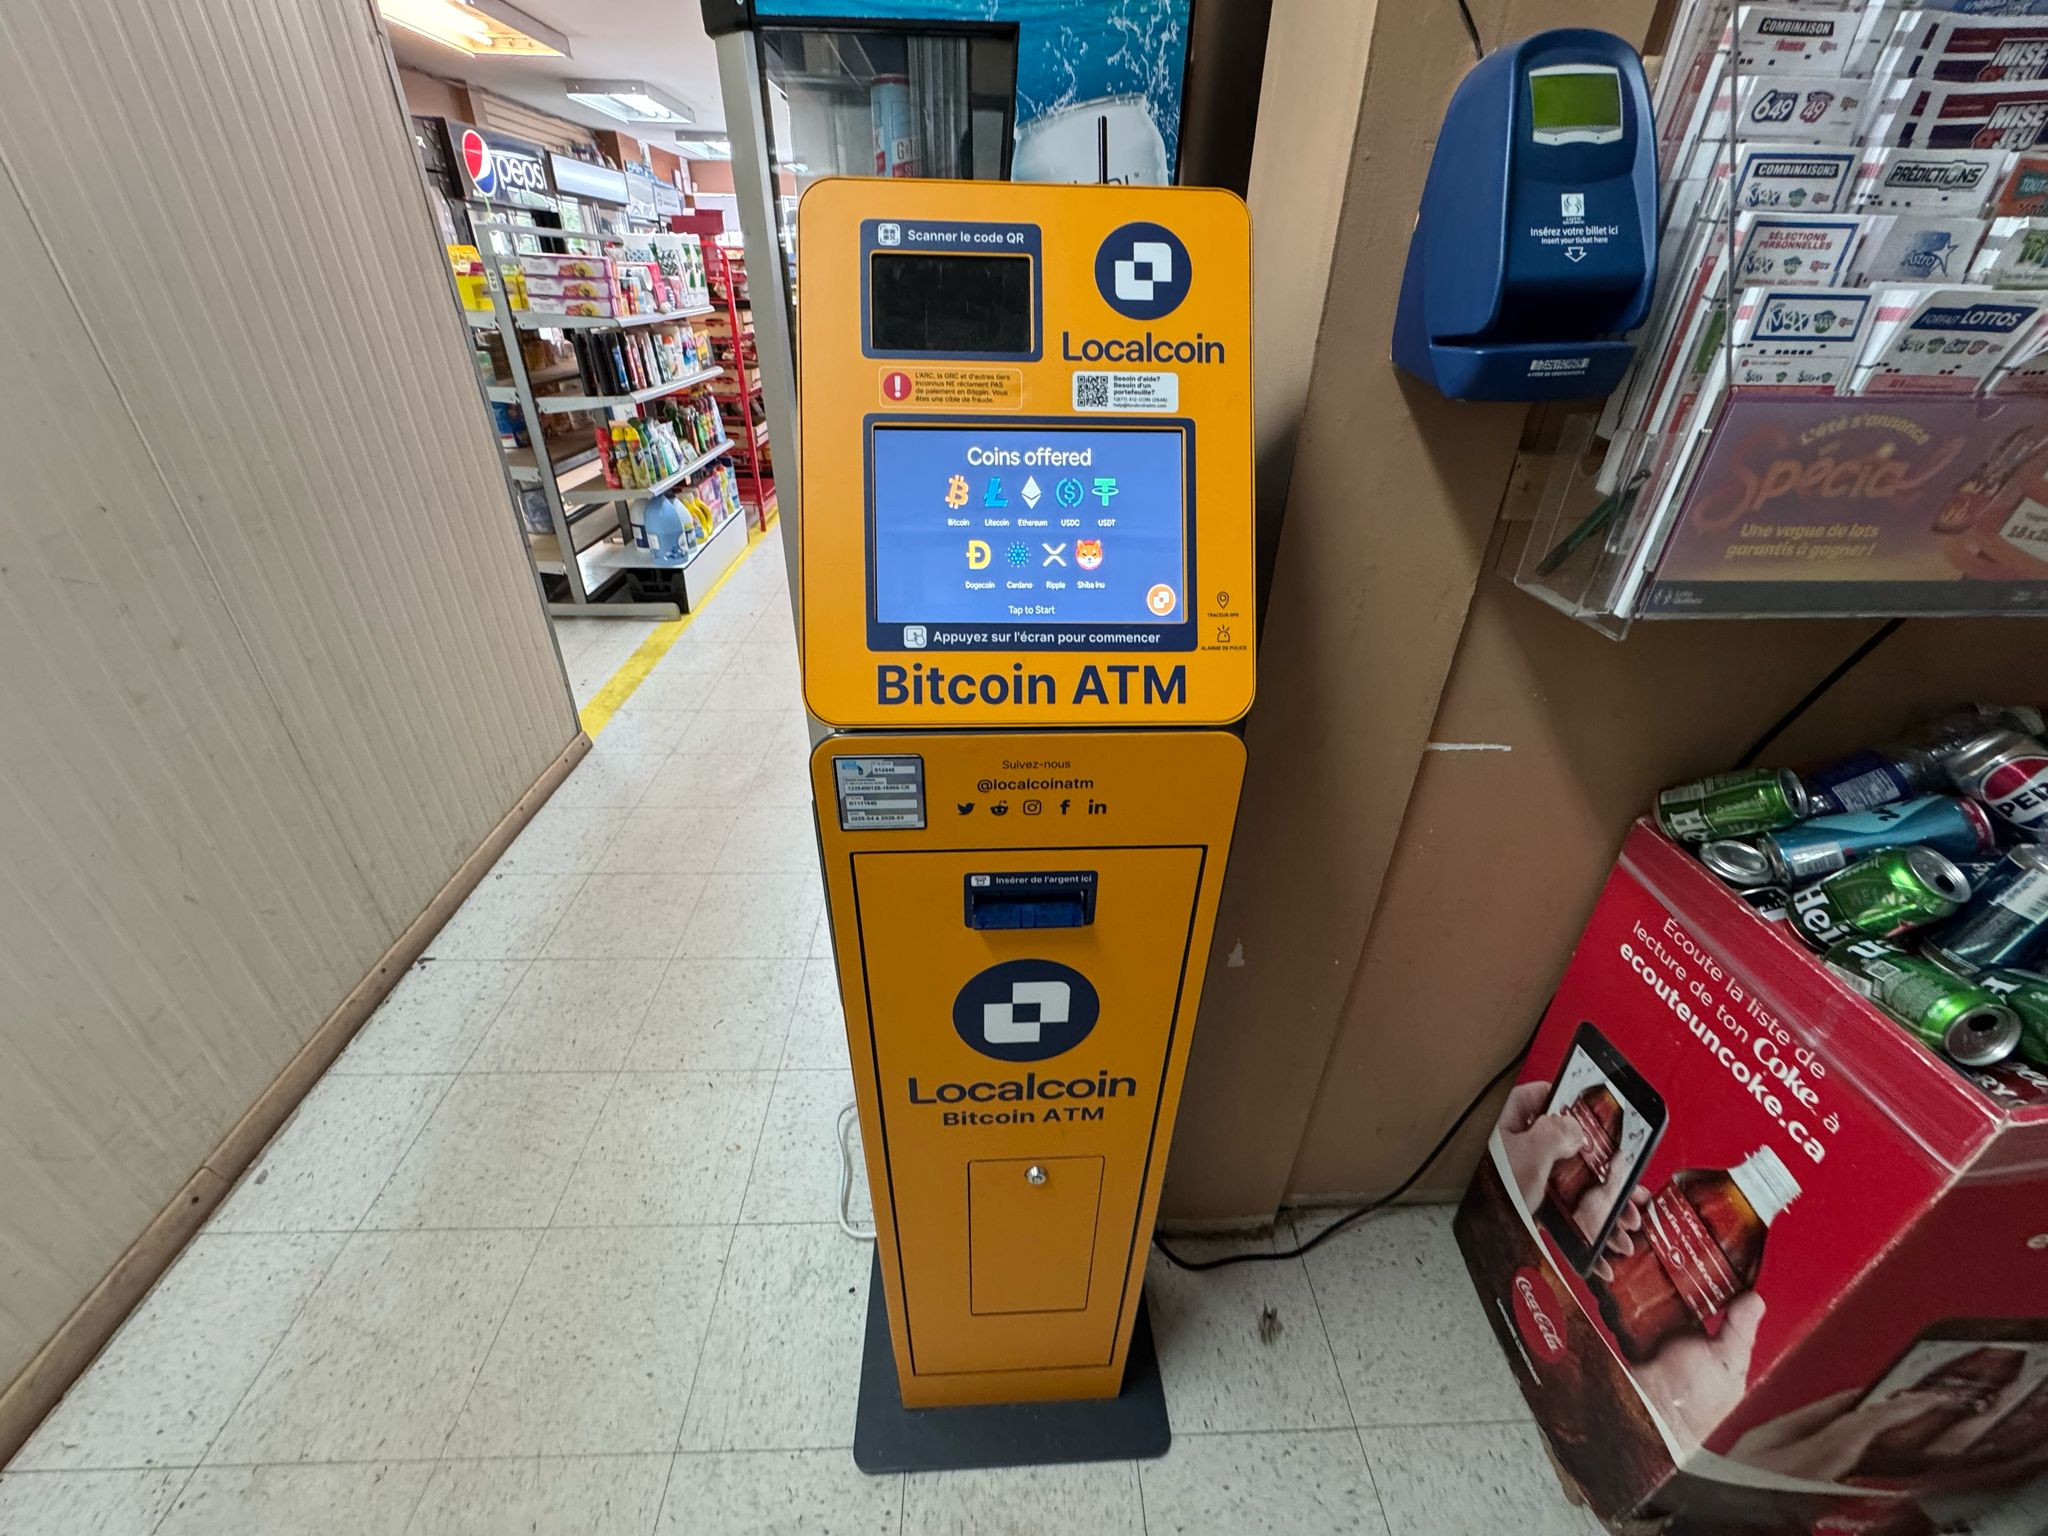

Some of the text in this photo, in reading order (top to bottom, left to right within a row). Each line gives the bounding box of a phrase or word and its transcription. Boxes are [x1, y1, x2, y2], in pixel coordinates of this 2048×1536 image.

[1762, 19, 1831, 34] COMBINAISON
[1987, 104, 2048, 129] MISE
[1992, 128, 2038, 150] JEU
[495, 155, 548, 192] pepsi
[1758, 163, 1836, 176] COMBINAISONS
[1890, 164, 1982, 184] PRÉDICTIONS
[907, 230, 1025, 246] Scanner le code QR
[1530, 225, 1618, 236] Insérez votre billet ici
[1768, 231, 1828, 240] SÉLECTIONS
[1560, 238, 1575, 246] your
[1758, 240, 1832, 250] PERSONNELLES
[1905, 252, 1936, 266] Astro
[1960, 310, 2022, 327] LOTTOS
[1062, 331, 1225, 364] Localcoin
[967, 447, 1093, 467] Coins offered
[948, 519, 1116, 527] Bitcoin Litecoin Ethereum USDC USDT
[1740, 523, 1879, 541] Une vague de lots
[1724, 542, 1877, 560] garantis à gagner!
[965, 581, 1105, 590] Dogecoin Cardano Ripple Shiba Inu
[1008, 605, 1056, 616] Tap to Start
[933, 630, 1161, 646] Appuyez sur l'écran pour commencer
[877, 662, 1187, 705] Bitcoin ATM
[1002, 759, 1071, 770] Suivez-nous
[976, 778, 1094, 793] @localcoinatm
[995, 875, 1092, 886] Insérer de l'argent ici
[1662, 915, 1826, 1080] Écoute la liste de
[1632, 919, 1841, 1134] lecture de ton Coke à
[1619, 942, 1826, 1164] ecouteuncoke.ca
[908, 1069, 1137, 1105] Localcoin
[943, 1106, 1105, 1127] Bitcoin ATM
